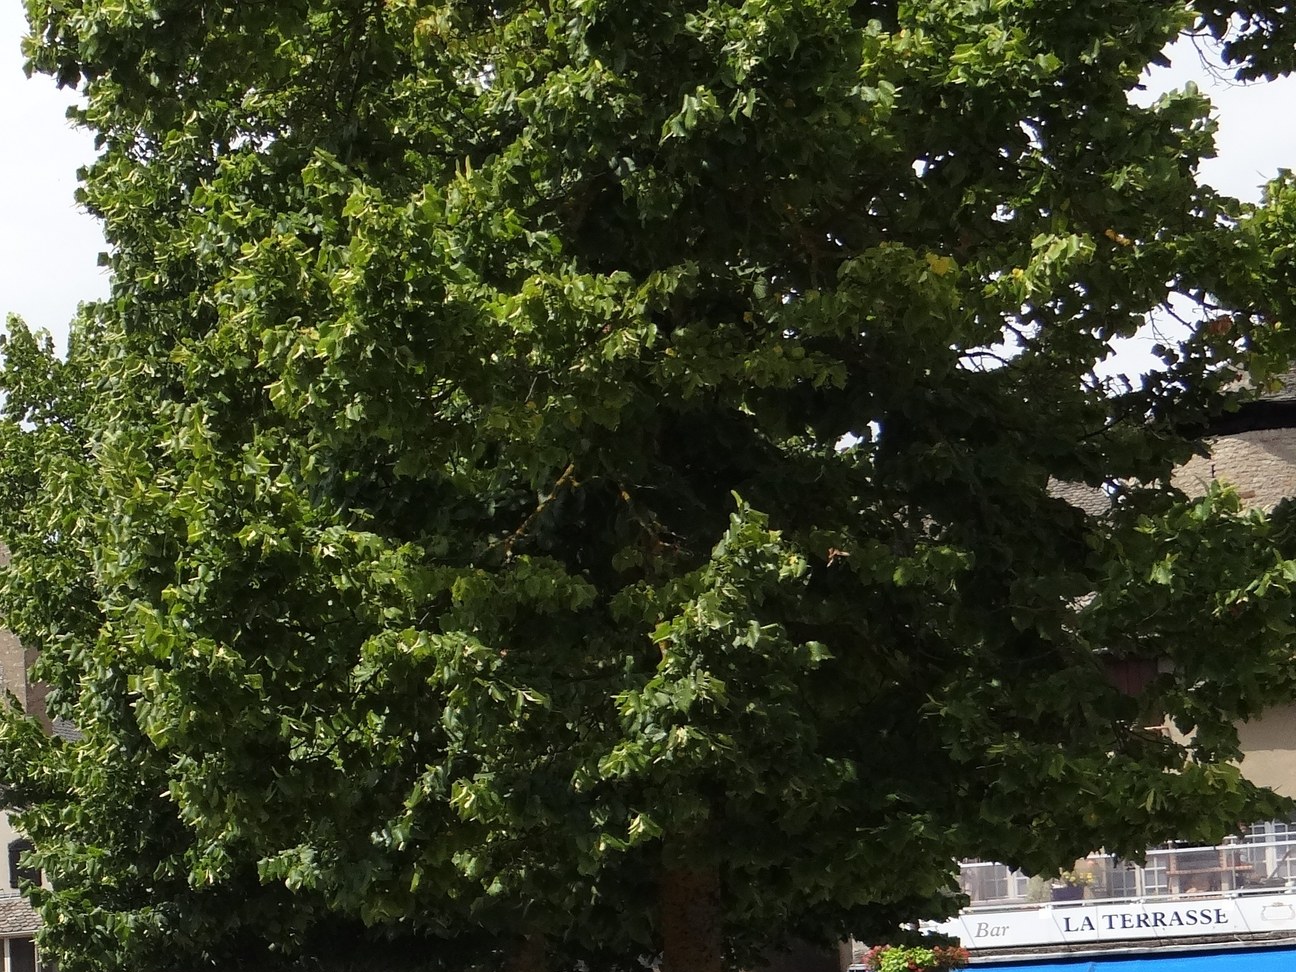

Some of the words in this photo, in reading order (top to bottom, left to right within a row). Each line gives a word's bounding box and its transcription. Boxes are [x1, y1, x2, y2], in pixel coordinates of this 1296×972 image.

[975, 922, 1010, 938] Bar
[1063, 915, 1095, 933] LA
[1101, 907, 1230, 931] TERRASSE
